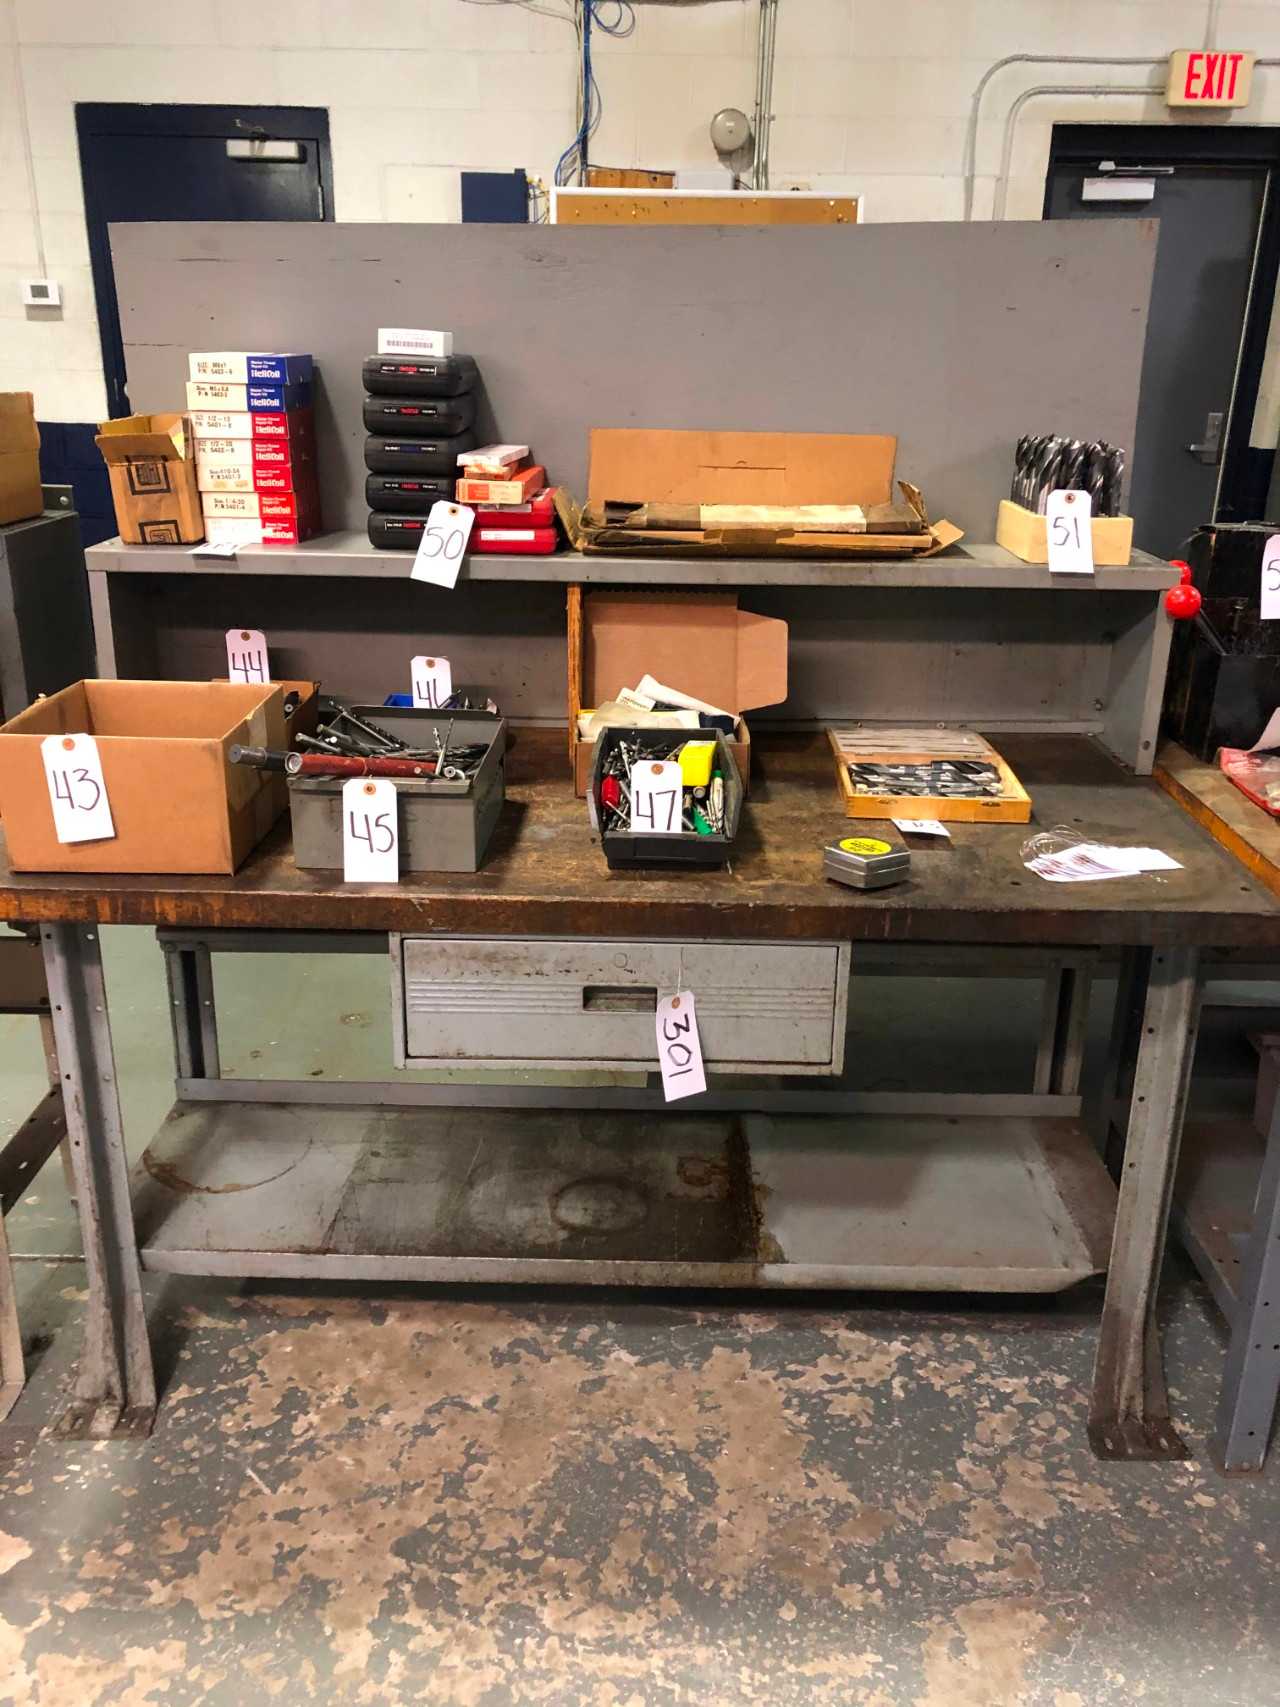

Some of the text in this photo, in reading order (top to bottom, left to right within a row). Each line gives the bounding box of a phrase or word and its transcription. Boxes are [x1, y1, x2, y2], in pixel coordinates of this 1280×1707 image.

[1184, 53, 1243, 100] EXIT
[422, 526, 465, 560] 50
[1052, 516, 1081, 549] 51
[231, 650, 265, 683] 44
[51, 768, 101, 811] 43
[636, 790, 677, 831] 47
[349, 811, 396, 854] 45
